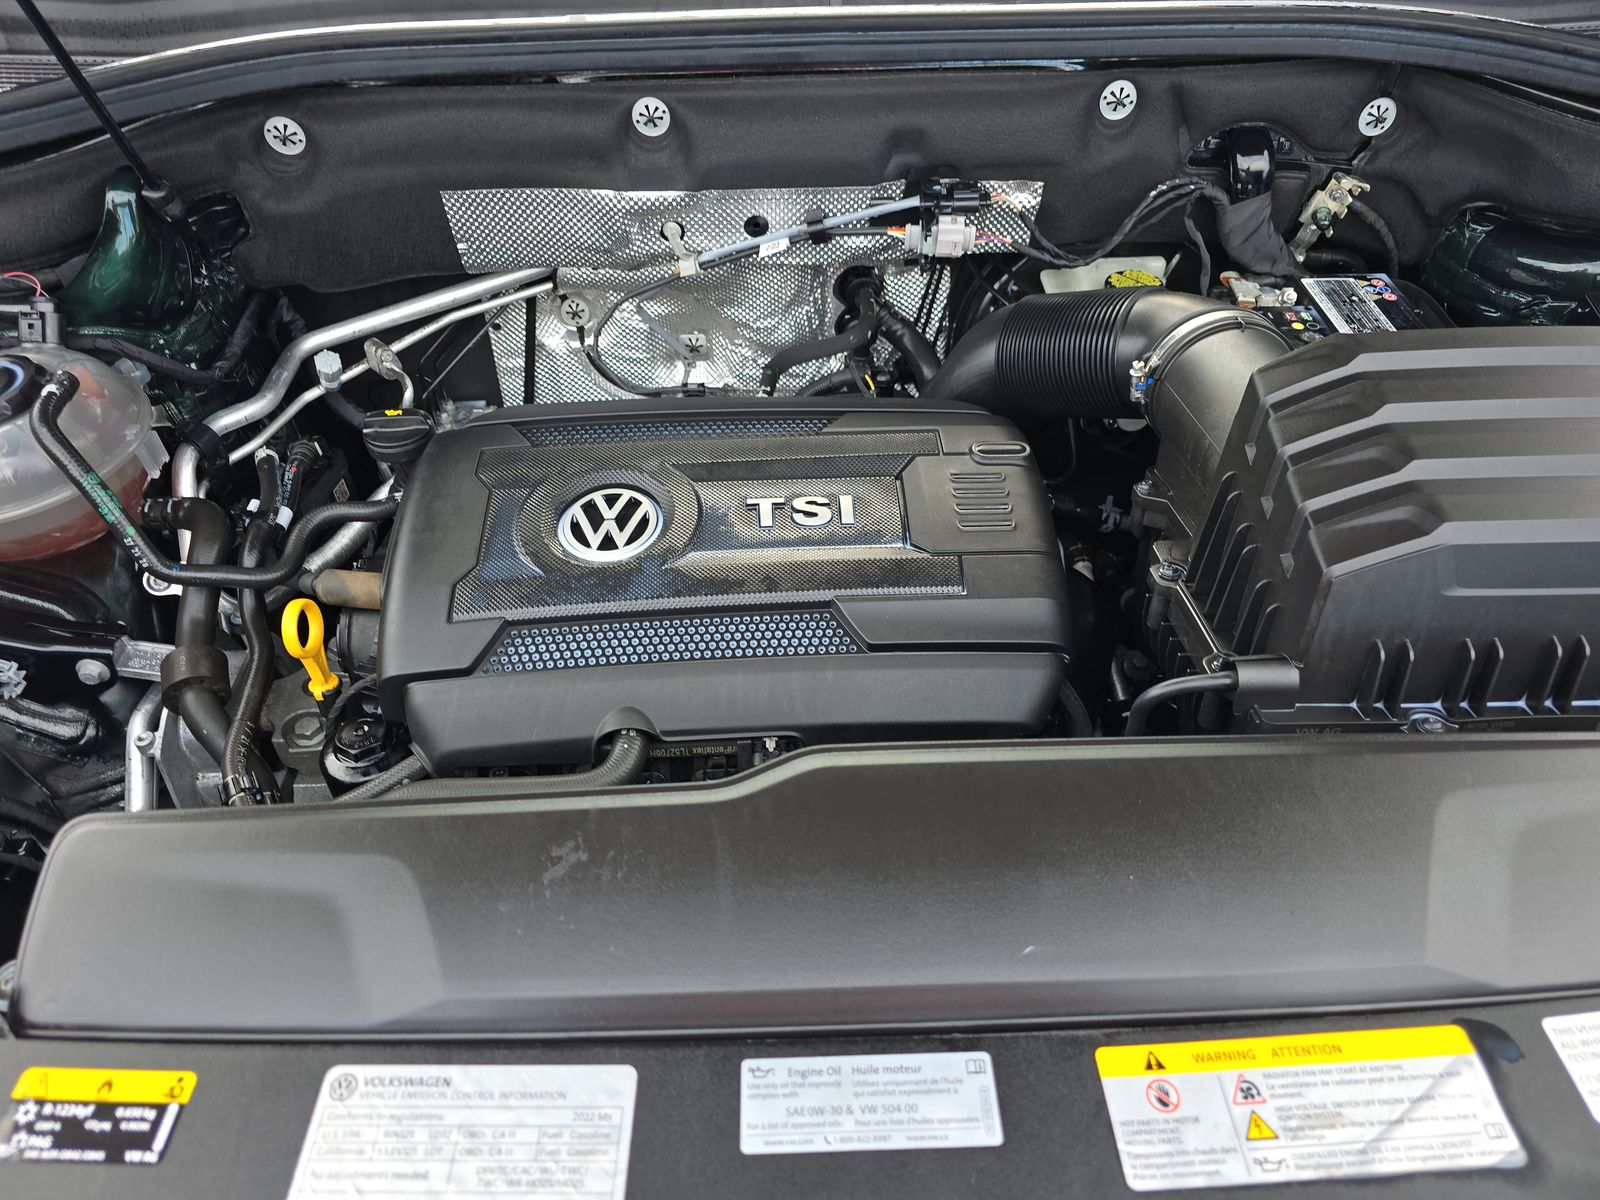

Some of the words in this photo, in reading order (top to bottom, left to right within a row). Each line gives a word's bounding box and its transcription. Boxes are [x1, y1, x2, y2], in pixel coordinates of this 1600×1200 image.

[746, 494, 855, 529] TSI
[1192, 1049, 1256, 1064] WARNING
[1271, 1043, 1343, 1059] ATTENTION
[787, 1067, 824, 1080] Engine
[826, 1065, 842, 1076] Oil
[851, 1064, 880, 1075] Huile
[882, 1064, 922, 1074] moteur
[363, 1076, 452, 1088] VOLKSWAGEN
[572, 1112, 595, 1122] 2022
[785, 1105, 806, 1118] SAE
[807, 1104, 843, 1117] 0W-30
[858, 1103, 879, 1114] VW
[881, 1103, 901, 1114] 504
[903, 1102, 919, 1113] 00
